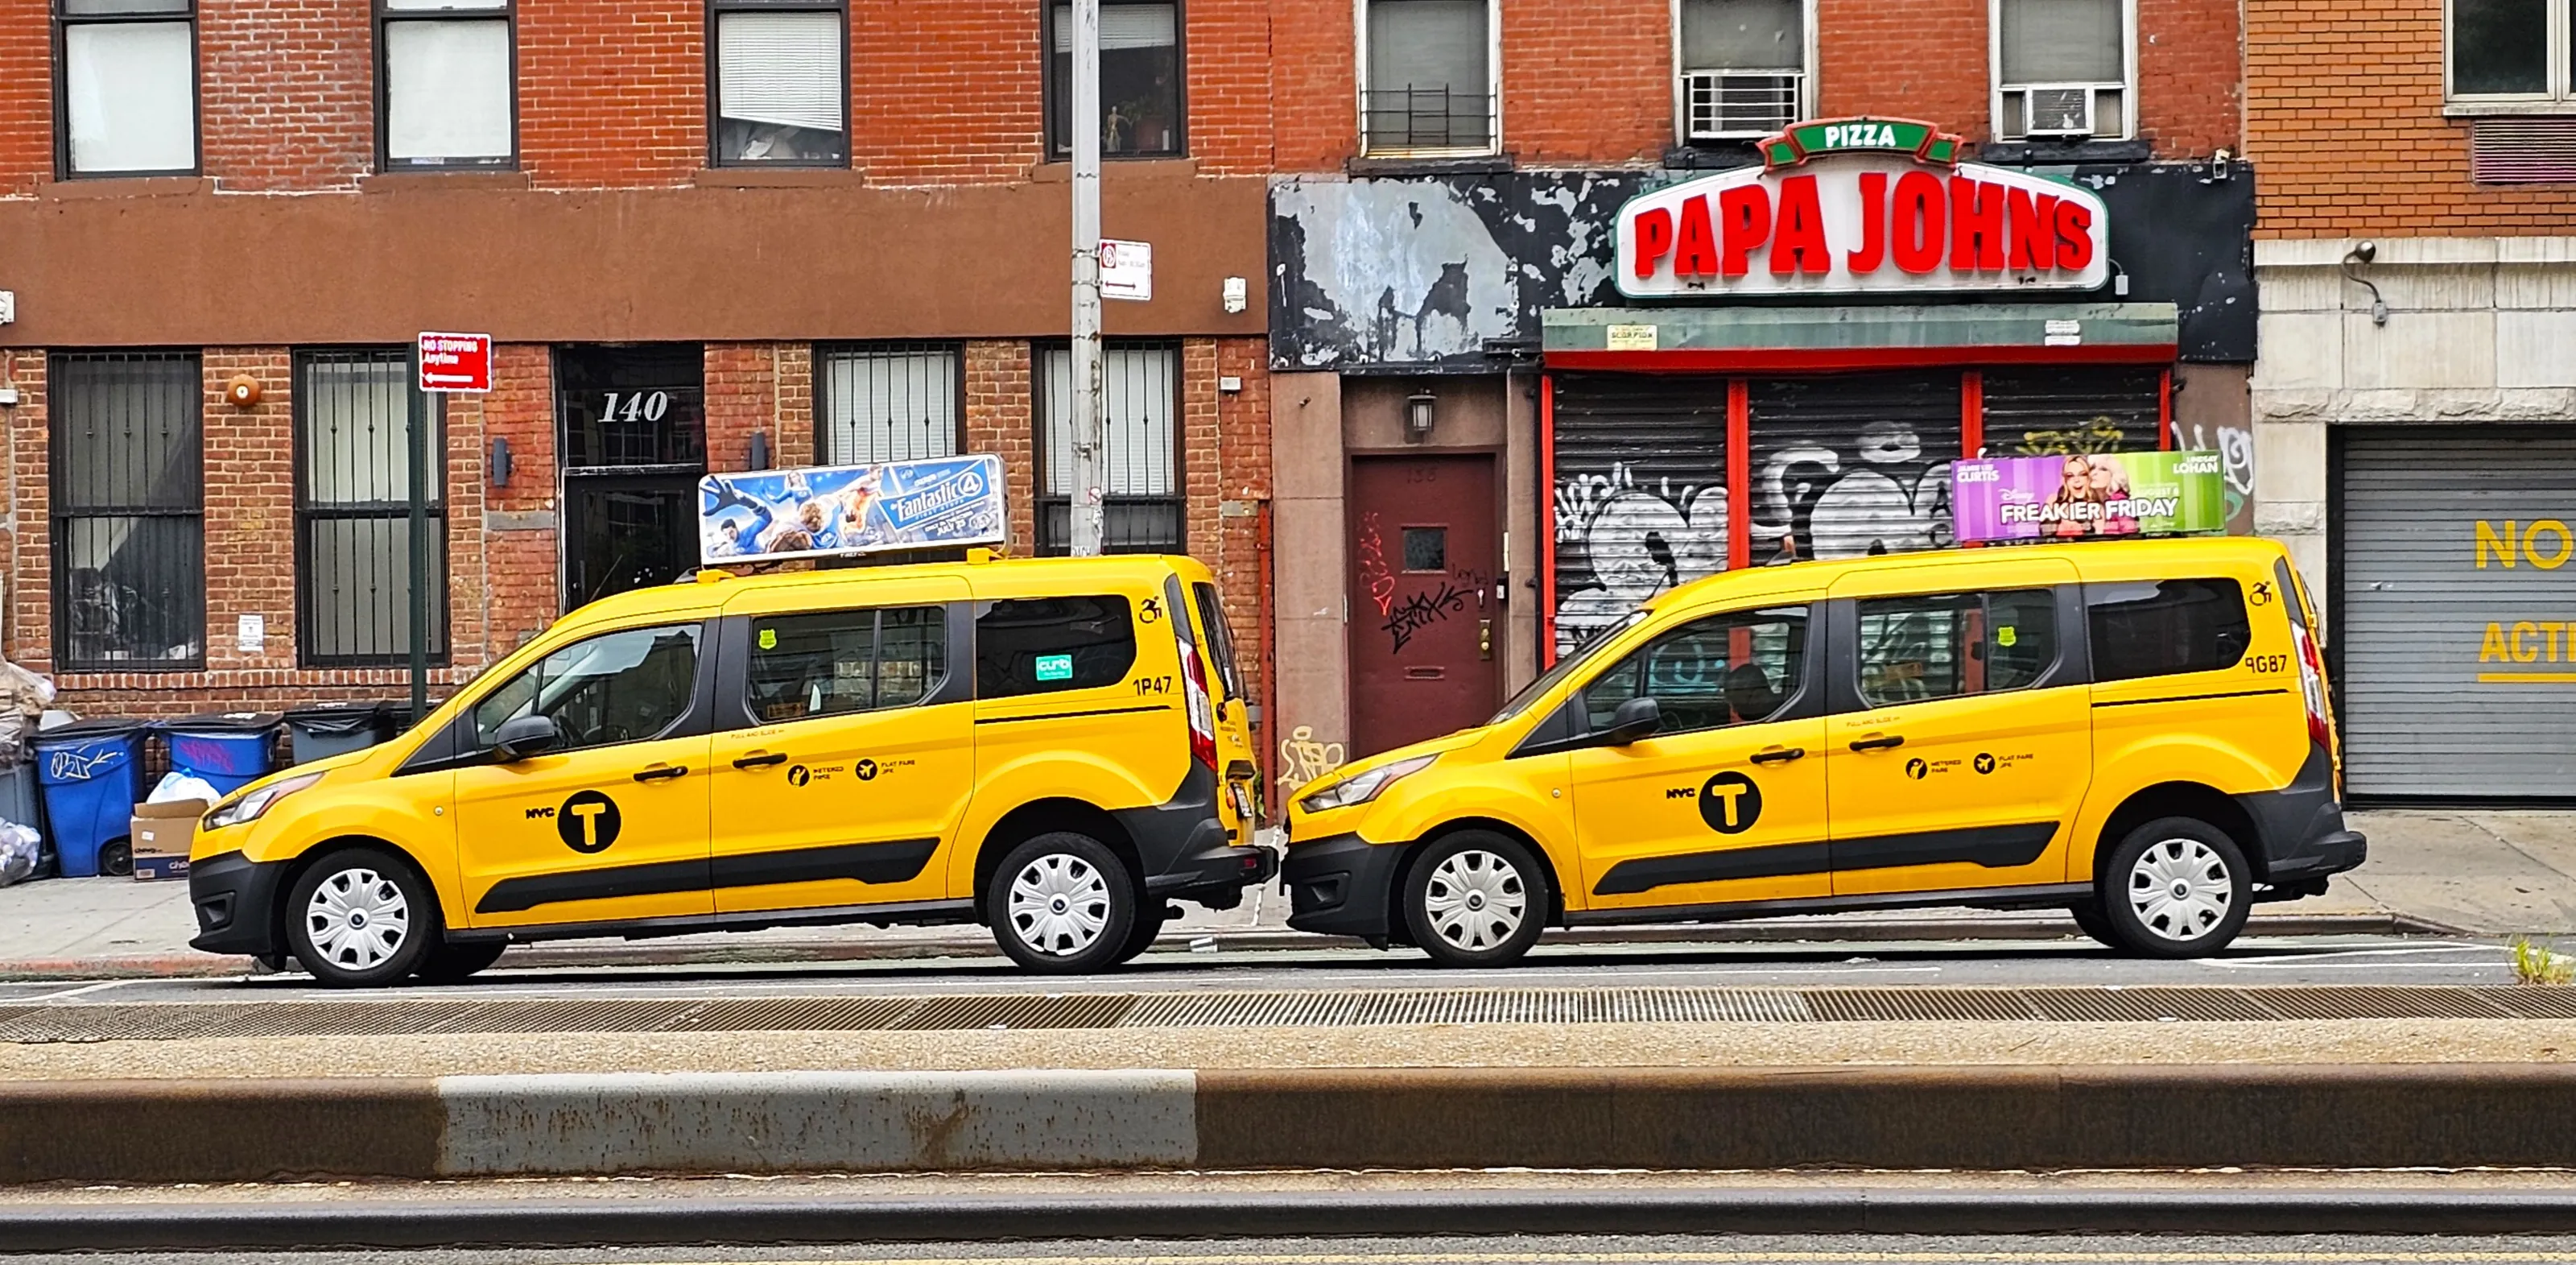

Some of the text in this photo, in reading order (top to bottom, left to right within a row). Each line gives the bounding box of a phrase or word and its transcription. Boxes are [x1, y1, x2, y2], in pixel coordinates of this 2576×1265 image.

[1824, 124, 1897, 147] PIZZA
[1635, 171, 2092, 277] PAPA JOHNS
[423, 339, 478, 353] NO STOPPING
[597, 391, 667, 423] 140
[1957, 470, 2000, 482] CURTIS
[2173, 462, 2218, 474] LOHAN
[896, 481, 961, 523] Fantastic
[961, 473, 980, 494] 4
[2000, 498, 2179, 524] FREAKIER FRIDAY
[2475, 519, 2574, 569] NO
[1038, 658, 1071, 672] curb
[2245, 655, 2287, 674] 9G87
[1133, 676, 1172, 696] 1P47
[1666, 782, 1747, 827] NYC T
[525, 802, 606, 846] NYC T
